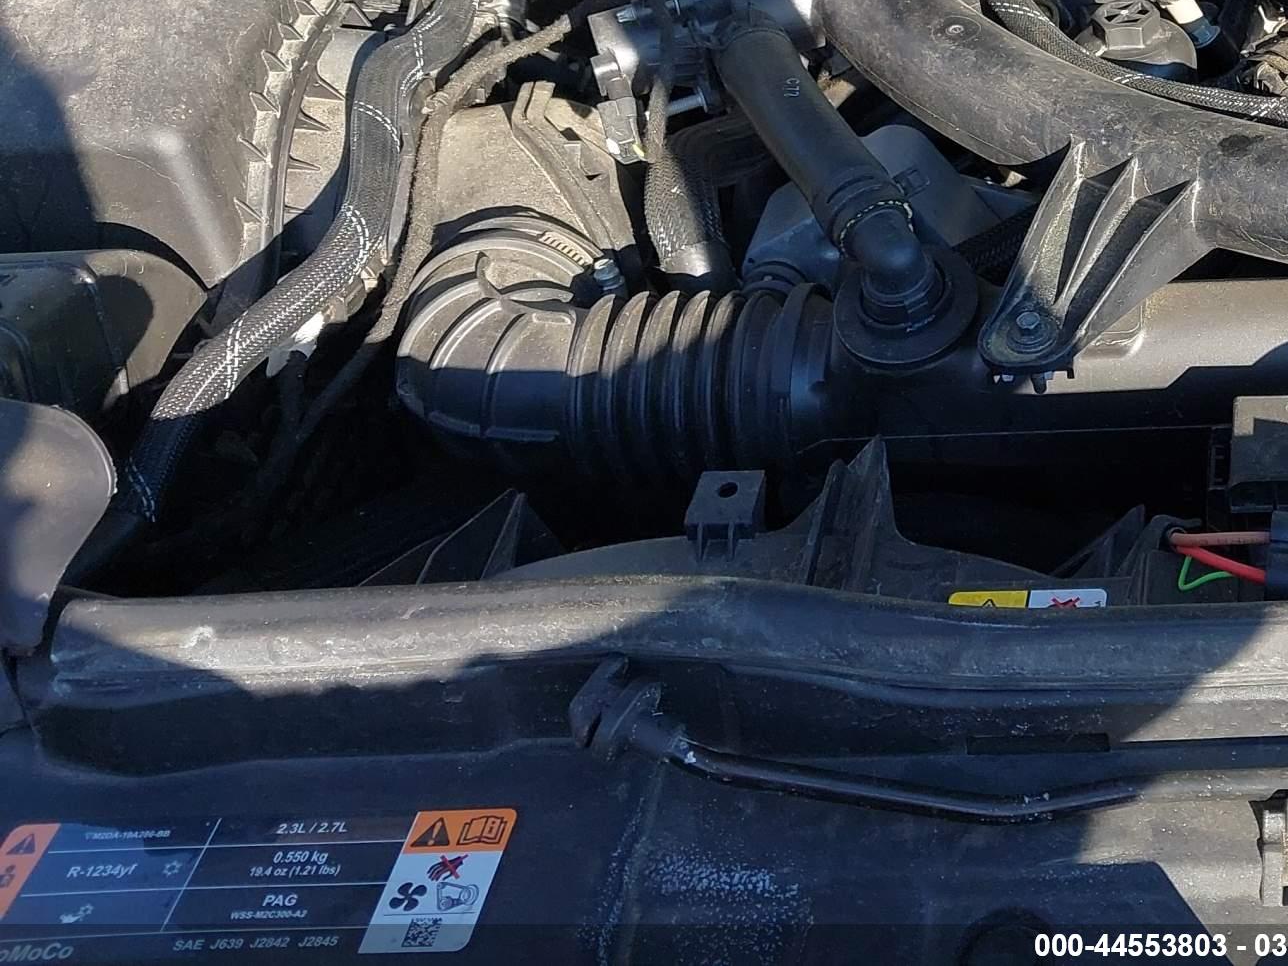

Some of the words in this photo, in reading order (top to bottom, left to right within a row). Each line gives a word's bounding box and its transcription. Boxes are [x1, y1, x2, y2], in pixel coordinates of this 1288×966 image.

[276, 823, 305, 834] 2.3L
[317, 822, 348, 833] 2.7L
[273, 851, 309, 864] 0.550
[311, 851, 328, 864] kg
[66, 863, 138, 879] R-1234yf
[250, 866, 271, 876] 19.4
[273, 867, 287, 876] oz
[288, 865, 315, 878] (1.21
[318, 864, 341, 876] lbs)
[262, 894, 298, 907] PAG
[172, 939, 204, 951] SAE
[209, 938, 244, 950] J639
[250, 937, 290, 949] J2842
[298, 936, 340, 948] J2845
[0, 942, 75, 962] oMoCo
